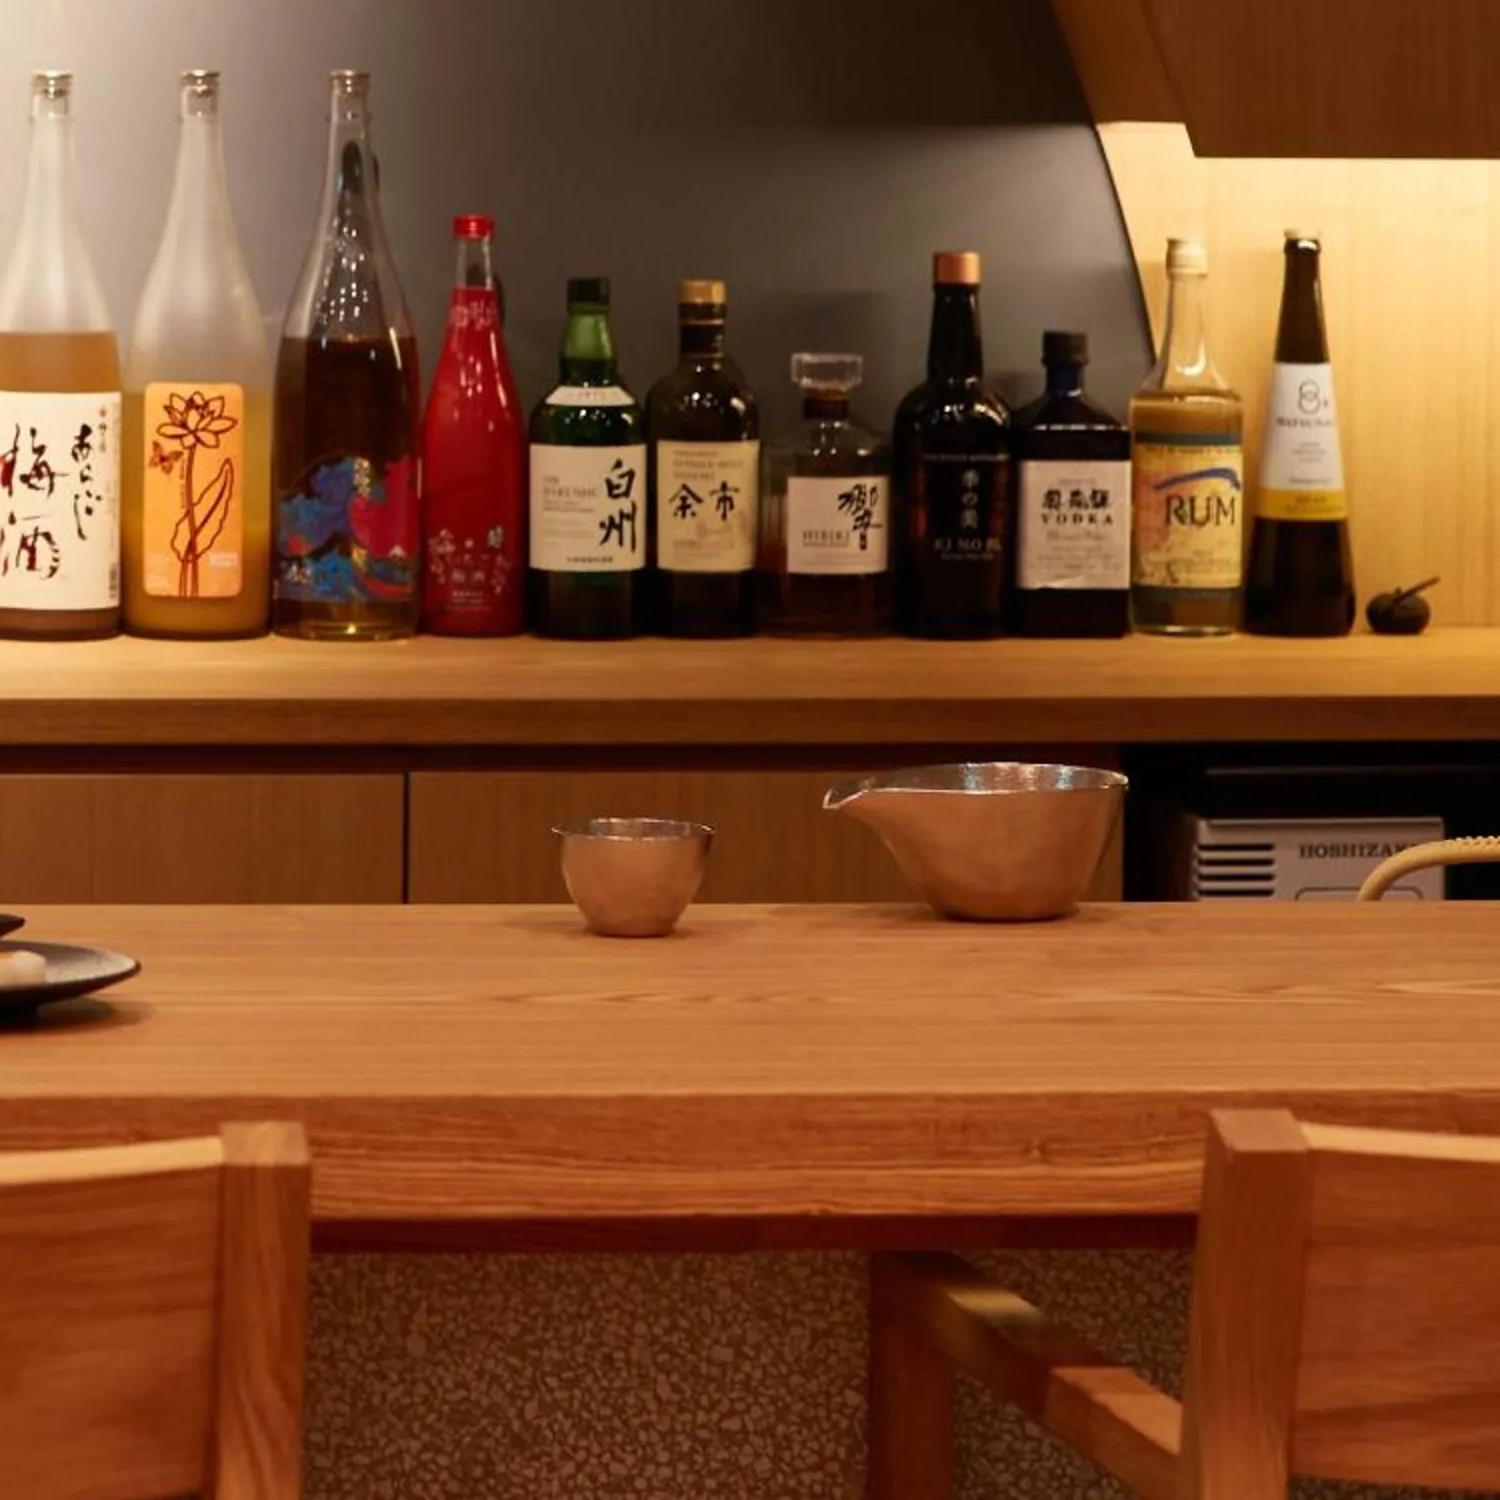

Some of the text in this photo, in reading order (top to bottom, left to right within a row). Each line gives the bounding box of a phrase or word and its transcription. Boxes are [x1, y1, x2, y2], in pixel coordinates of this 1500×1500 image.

[598, 457, 637, 554] 白州
[667, 480, 741, 521] 余市
[1164, 495, 1236, 527] RUM
[1040, 513, 1114, 526] VODKA
